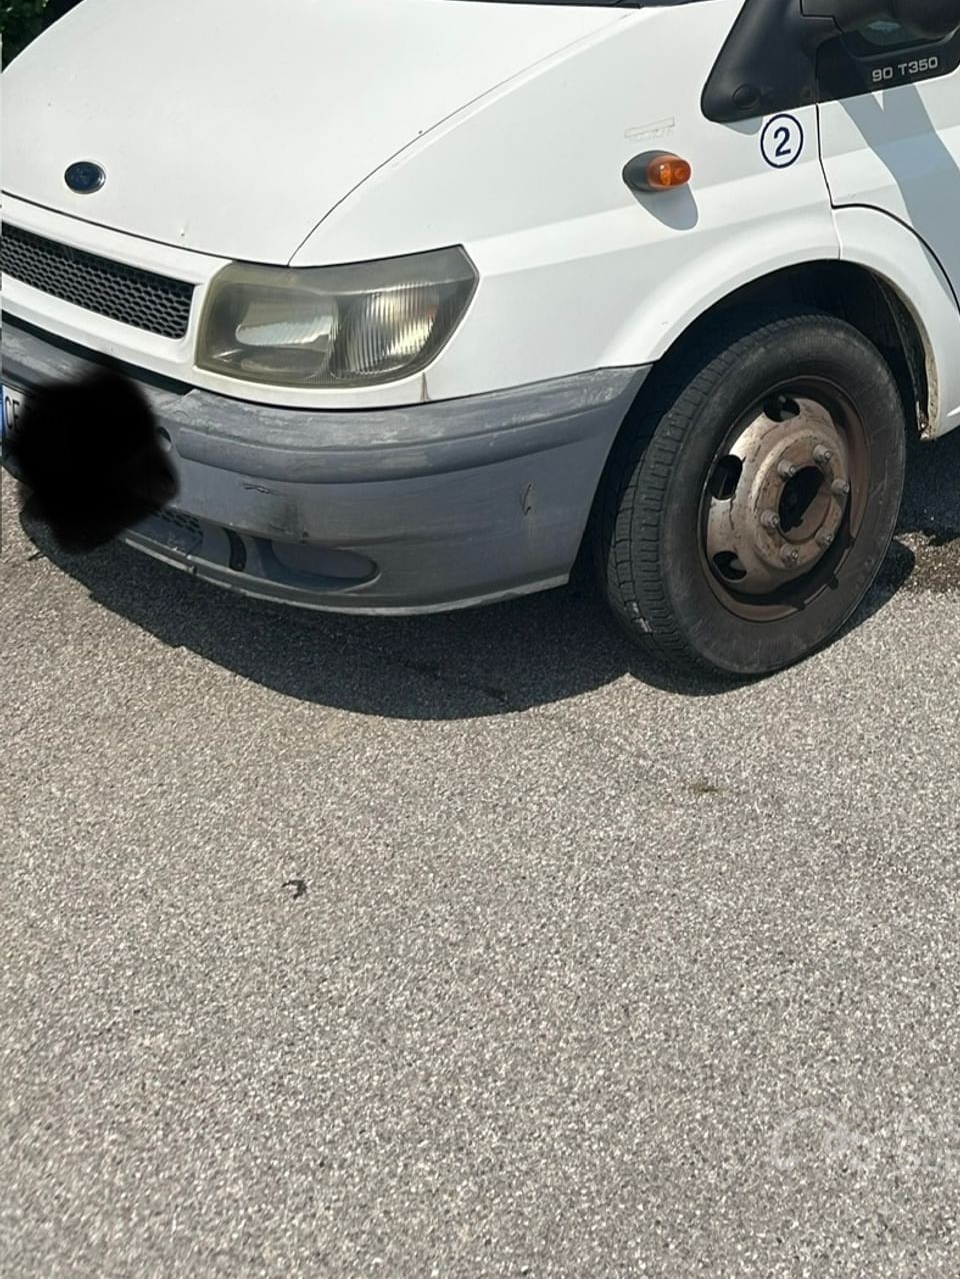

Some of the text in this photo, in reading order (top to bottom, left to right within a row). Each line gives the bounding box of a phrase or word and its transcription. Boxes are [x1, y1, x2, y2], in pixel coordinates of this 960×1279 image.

[871, 56, 939, 83] 90 T350
[773, 126, 792, 157] 2
